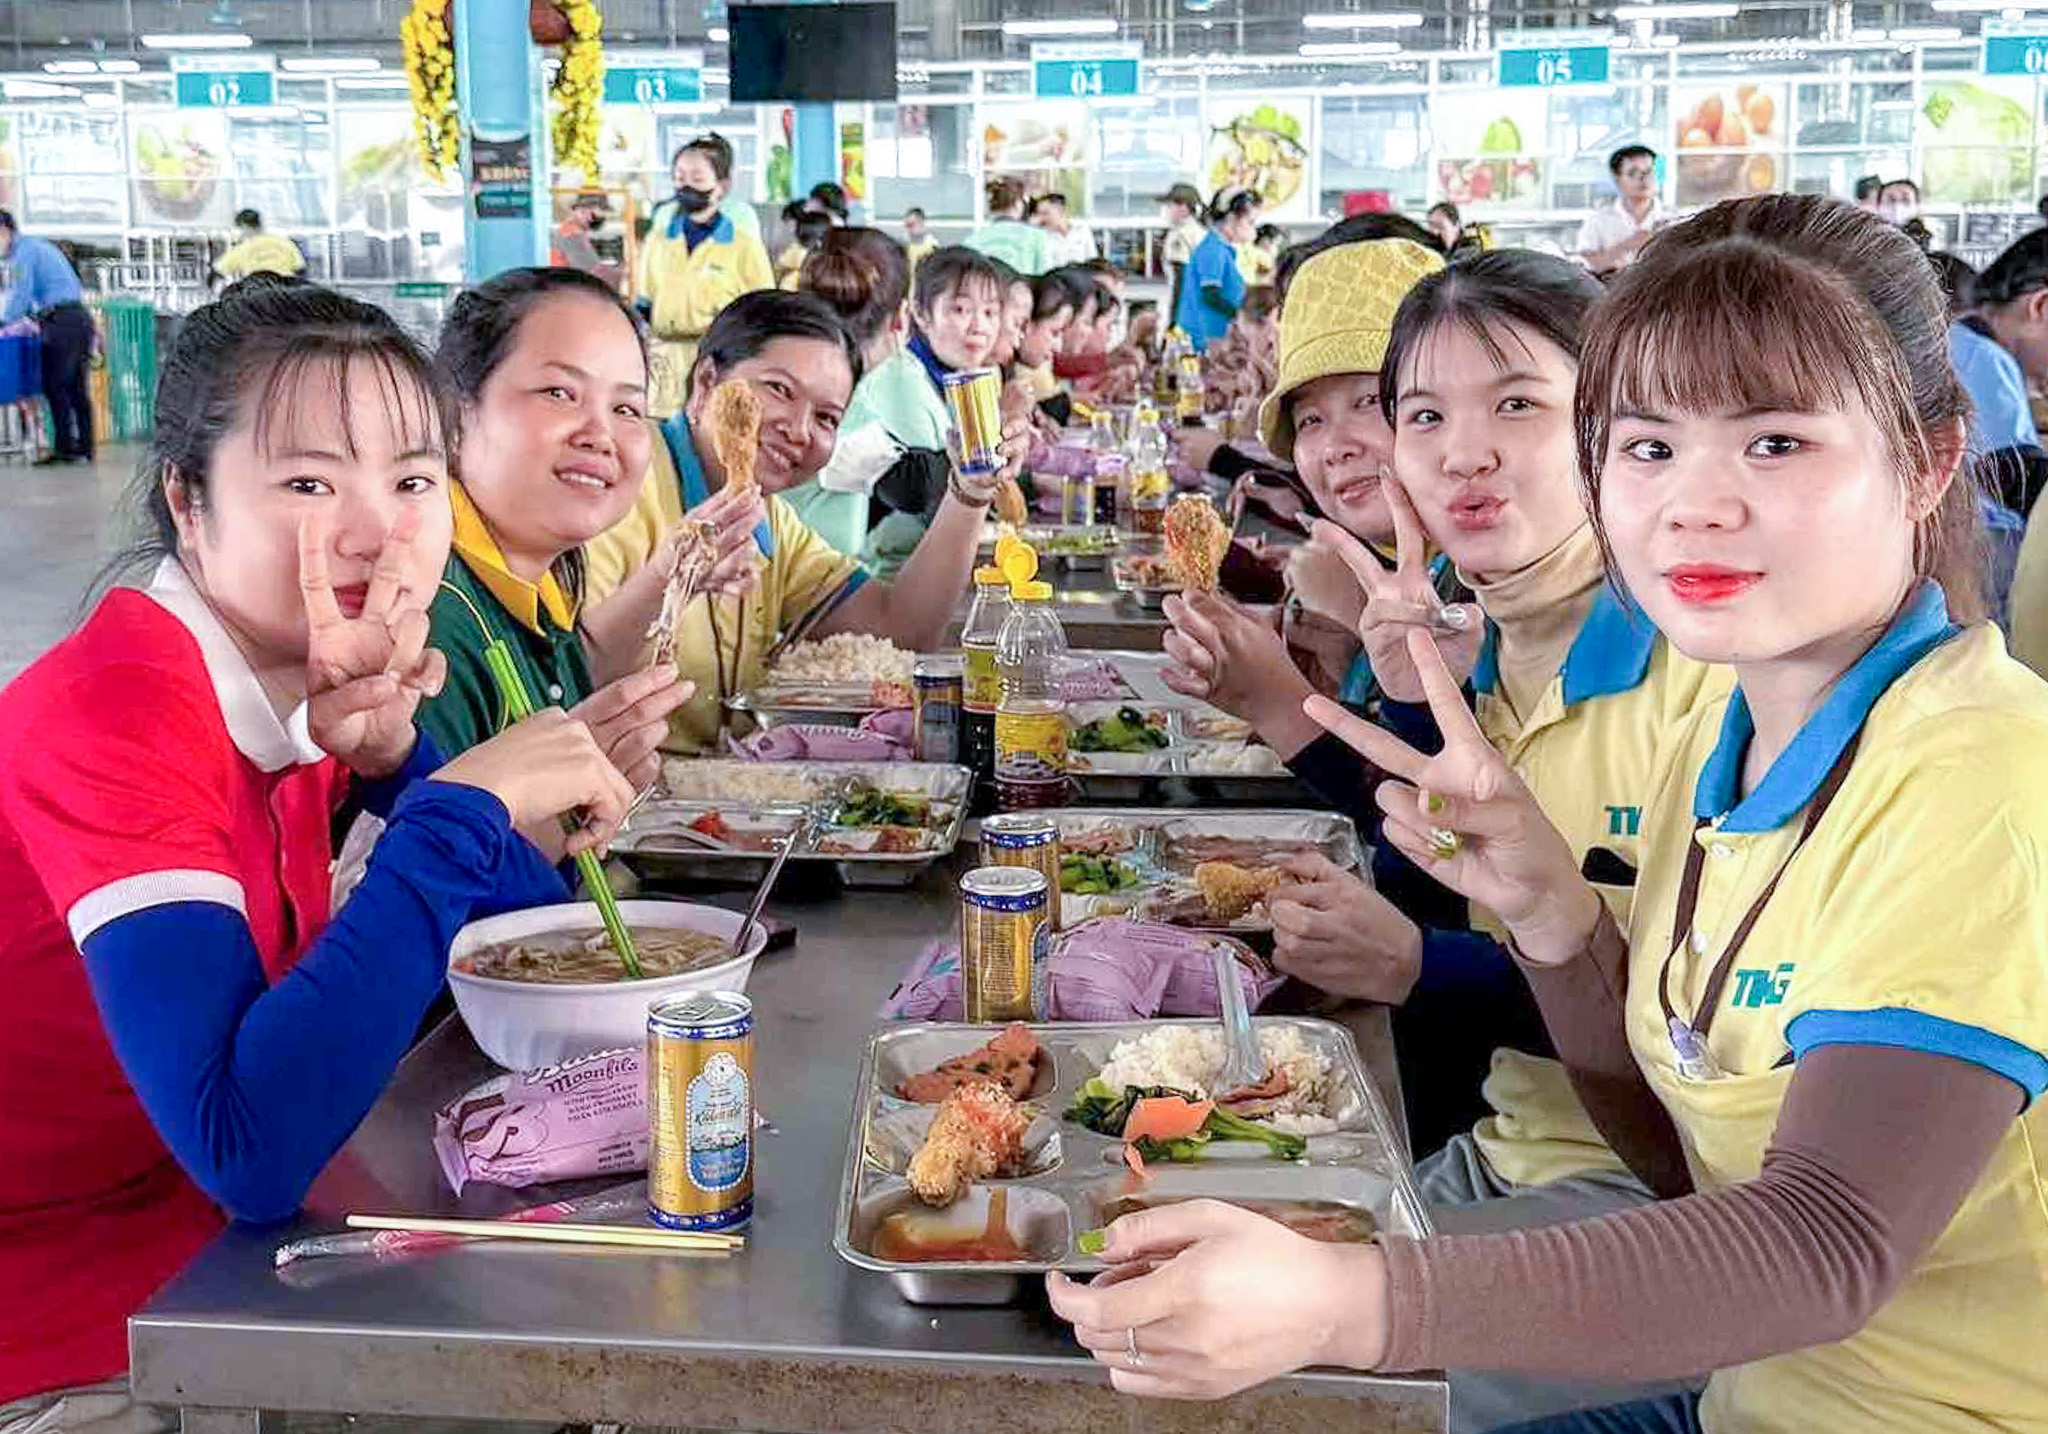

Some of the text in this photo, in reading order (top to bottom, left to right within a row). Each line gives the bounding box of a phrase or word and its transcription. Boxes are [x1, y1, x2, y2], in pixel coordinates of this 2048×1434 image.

[1537, 58, 1572, 85] 05
[2025, 46, 2048, 74] 0
[209, 80, 239, 106] 02
[635, 77, 666, 104] 03
[1070, 69, 1102, 97] 04
